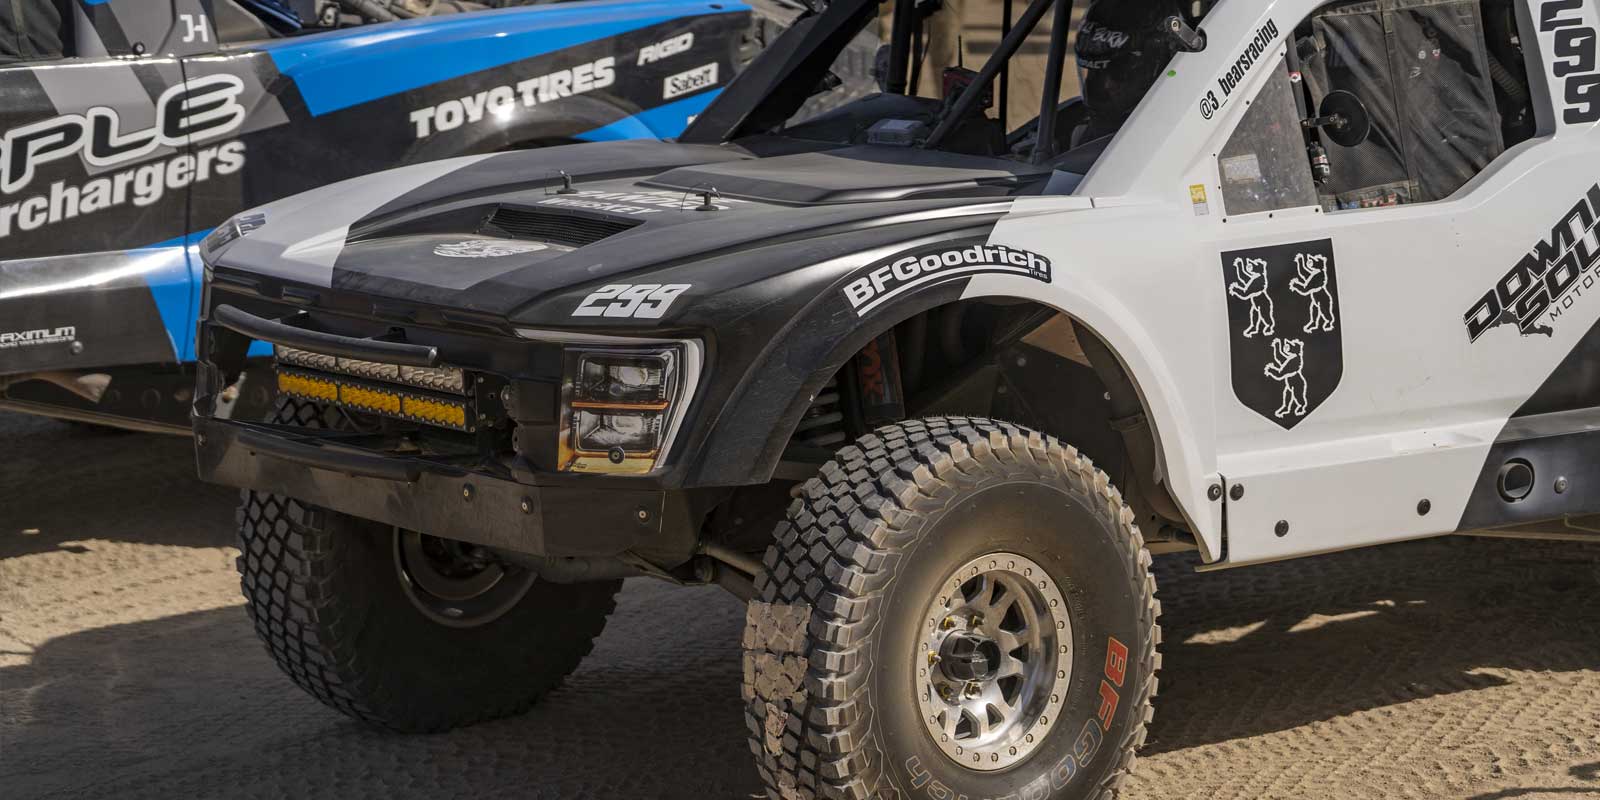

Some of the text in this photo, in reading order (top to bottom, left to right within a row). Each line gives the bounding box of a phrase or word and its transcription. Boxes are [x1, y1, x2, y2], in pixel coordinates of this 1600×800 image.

[637, 32, 694, 66] RIGID
[1200, 18, 1279, 120] @3_bearsracing
[0, 73, 245, 194] PLE
[410, 57, 615, 138] TOYO TIRES
[0, 141, 246, 238] rchargers
[571, 283, 692, 318] 299
[843, 244, 1047, 309] BFGoodrich
[1030, 268, 1048, 279] Tires
